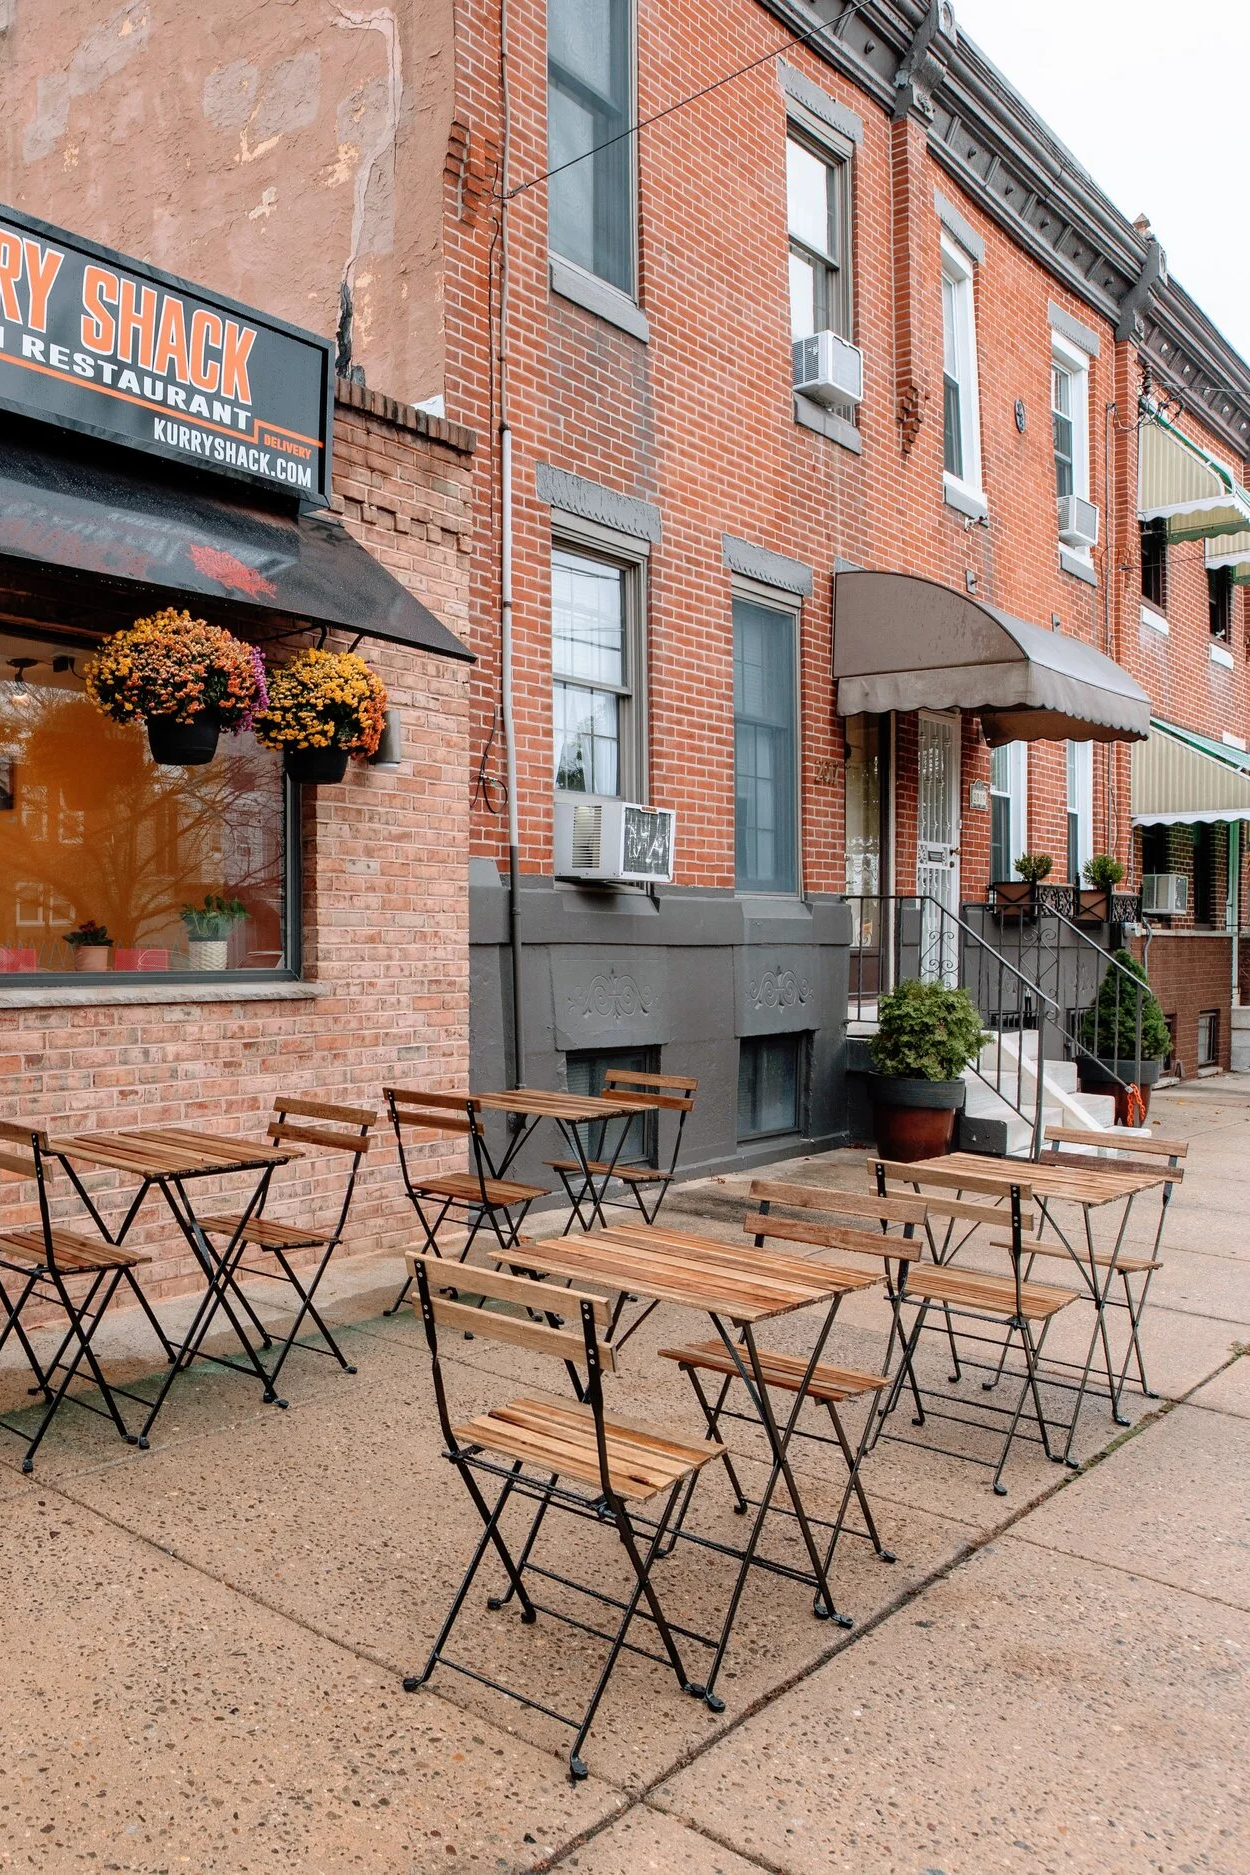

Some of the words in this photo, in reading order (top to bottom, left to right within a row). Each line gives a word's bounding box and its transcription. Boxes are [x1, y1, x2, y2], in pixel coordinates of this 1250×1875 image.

[80, 264, 258, 406] SHACK
[21, 333, 252, 431] RESTAURANT
[153, 417, 312, 489] KURRYSHACK.COM
[263, 433, 312, 461] DELIVERY
